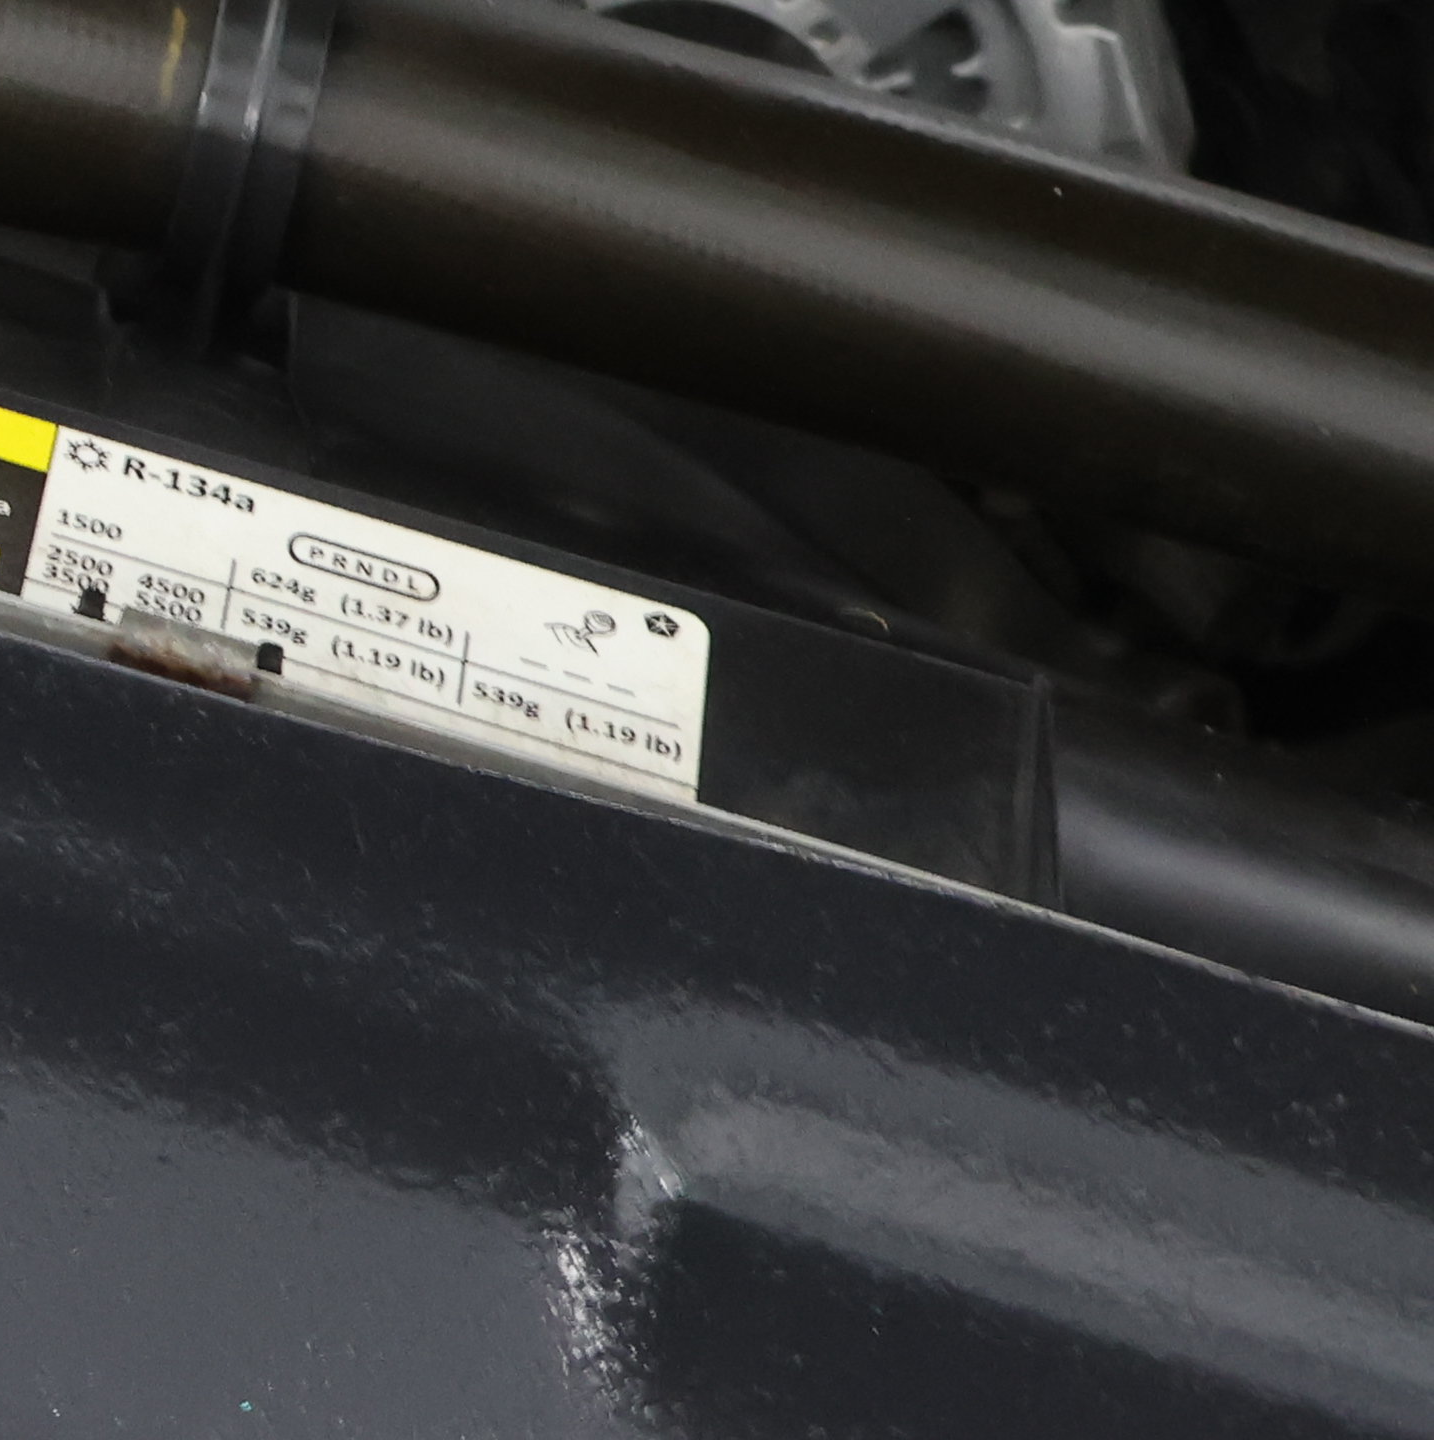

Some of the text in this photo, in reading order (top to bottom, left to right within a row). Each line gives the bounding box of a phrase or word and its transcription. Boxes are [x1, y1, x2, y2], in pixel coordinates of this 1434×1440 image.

[123, 454, 256, 514] R-134a
[57, 509, 123, 541] 1500
[47, 544, 114, 577] 2500
[137, 572, 206, 605] 4500
[251, 567, 316, 605] 624g
[417, 617, 454, 647] lb)
[241, 607, 308, 646] 539g
[410, 659, 446, 689] lb)
[473, 680, 540, 719] 539g
[644, 734, 682, 766] lb)
